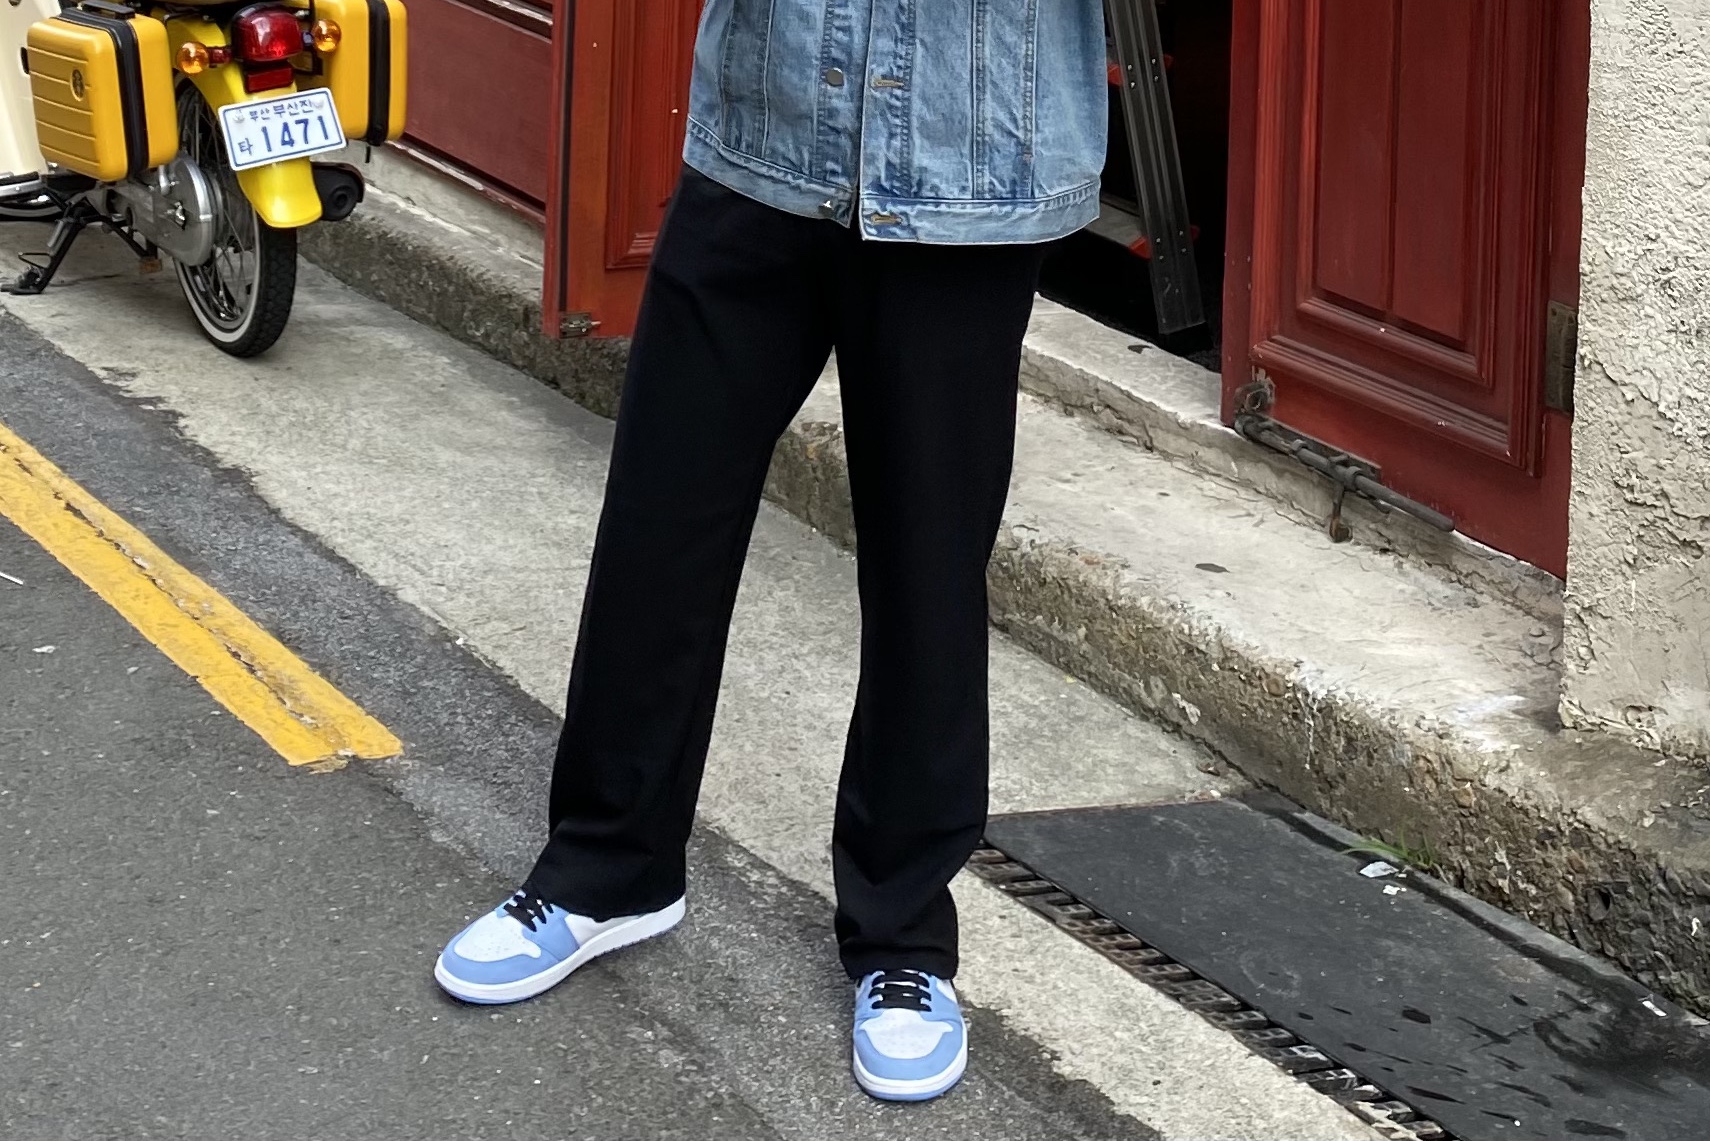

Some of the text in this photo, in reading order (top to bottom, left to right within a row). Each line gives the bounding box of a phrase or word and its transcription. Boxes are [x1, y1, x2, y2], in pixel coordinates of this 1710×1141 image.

[249, 98, 314, 122] 부산 부산진
[238, 115, 329, 156] 타 1471
